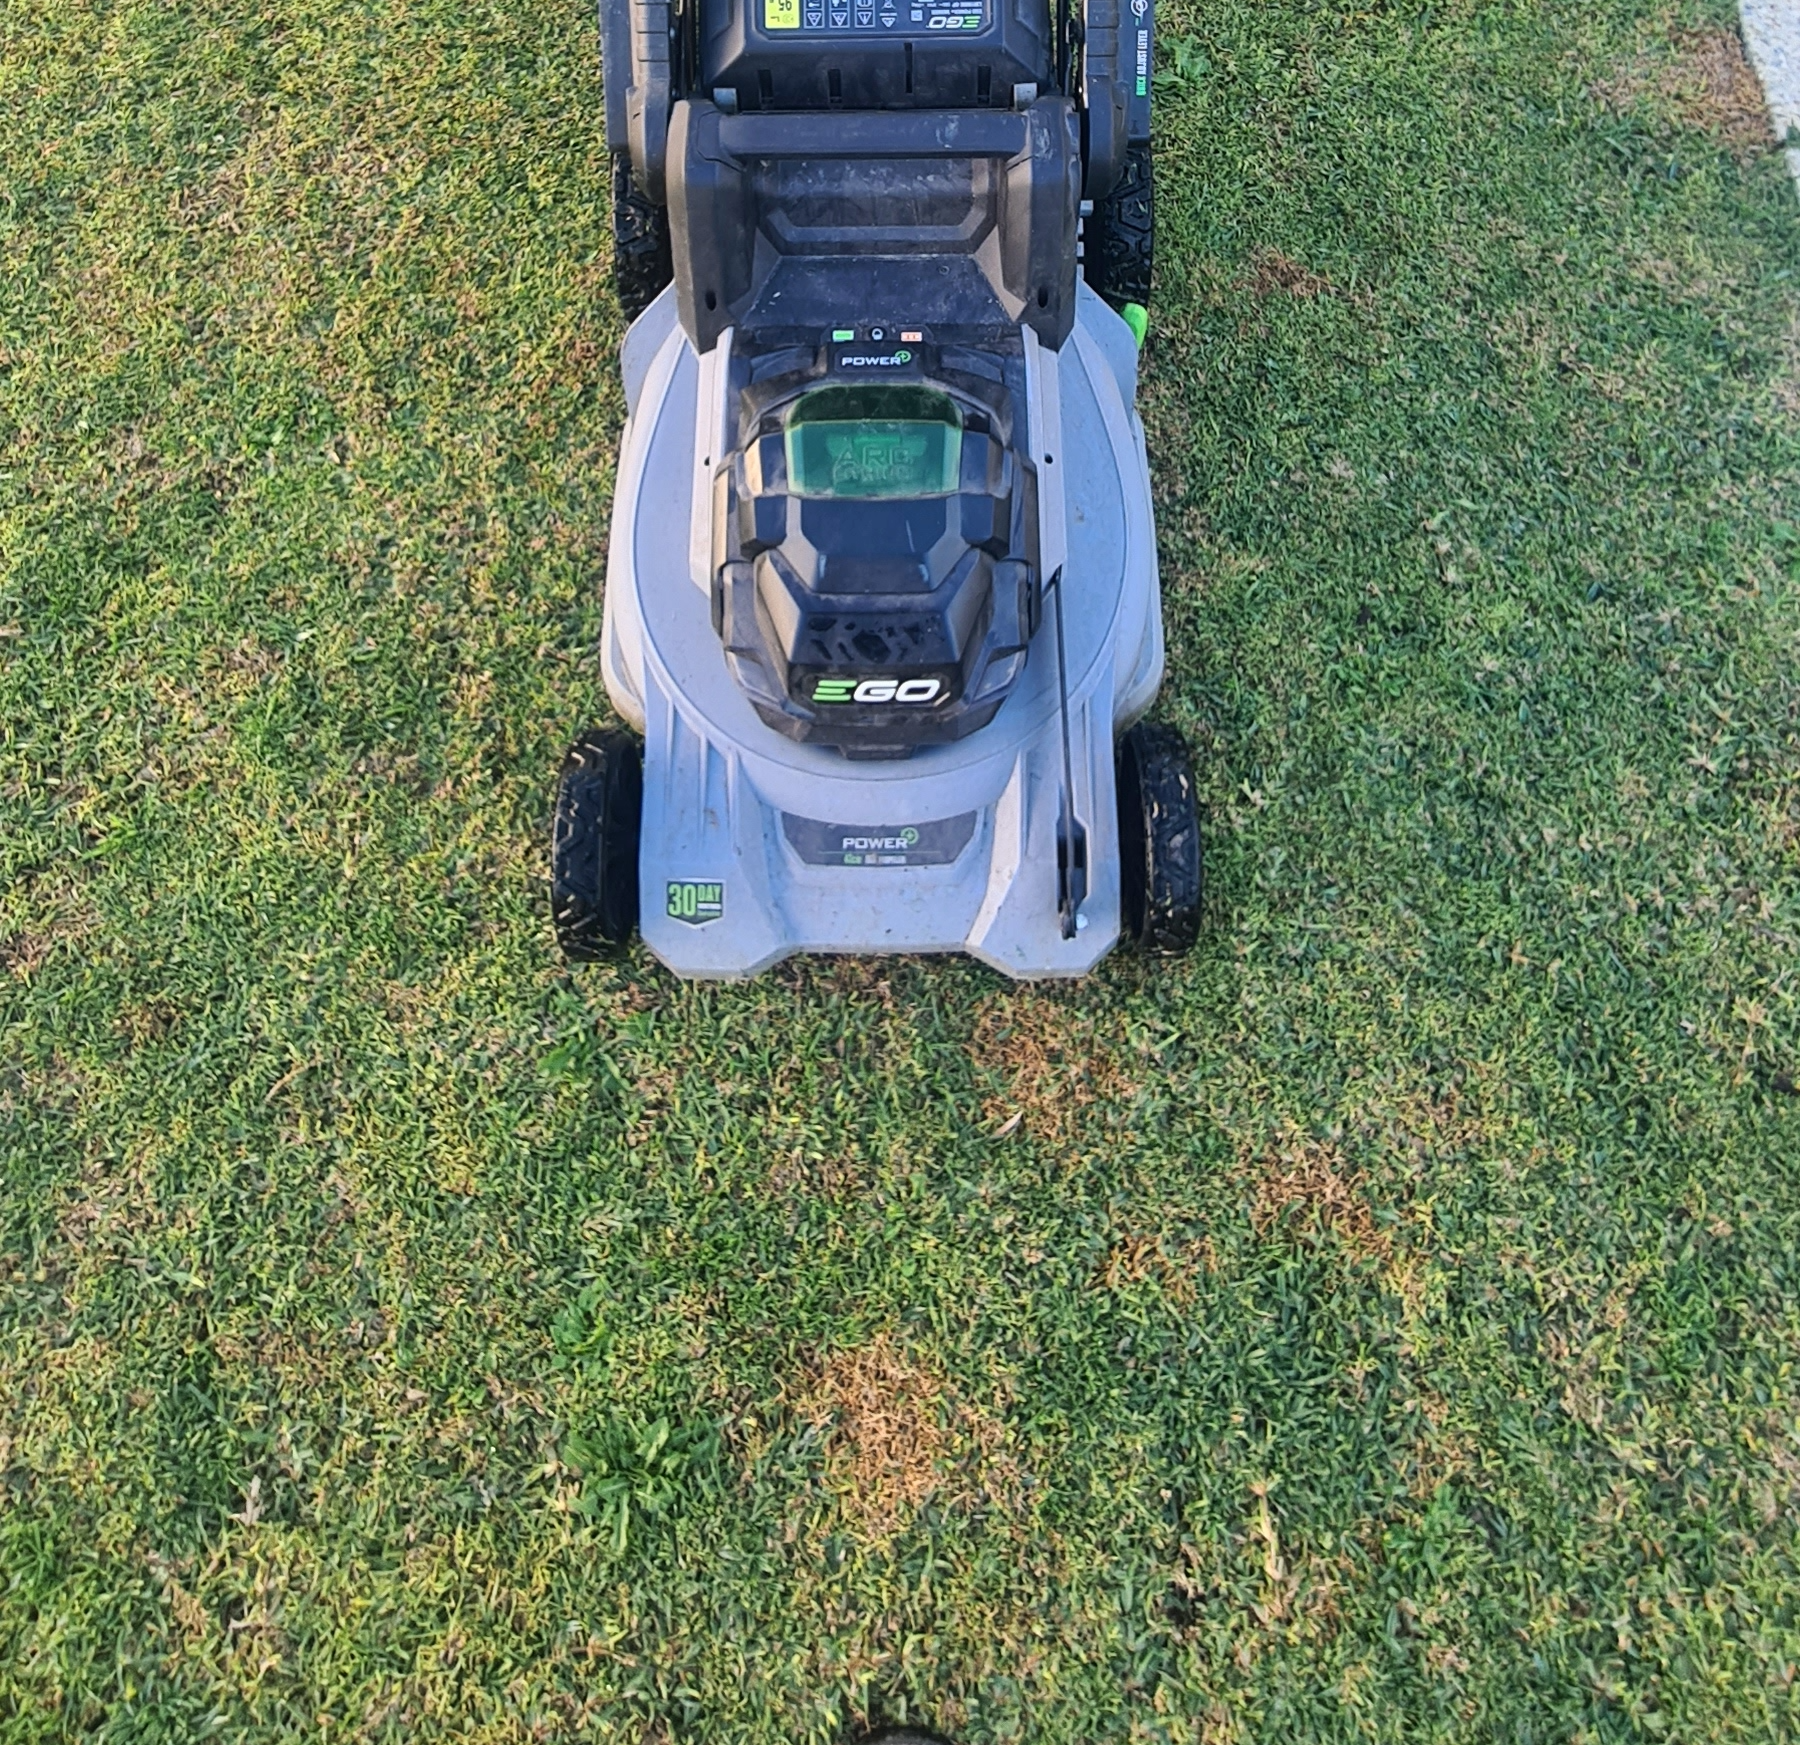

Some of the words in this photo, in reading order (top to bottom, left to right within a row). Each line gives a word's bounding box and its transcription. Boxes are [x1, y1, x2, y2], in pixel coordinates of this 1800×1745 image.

[928, 16, 981, 29] EGO
[1137, 30, 1148, 50] LEVER
[1136, 50, 1147, 75] ADJUST
[812, 679, 941, 702] EGO
[668, 883, 697, 916] 30
[697, 884, 721, 902] DAY
